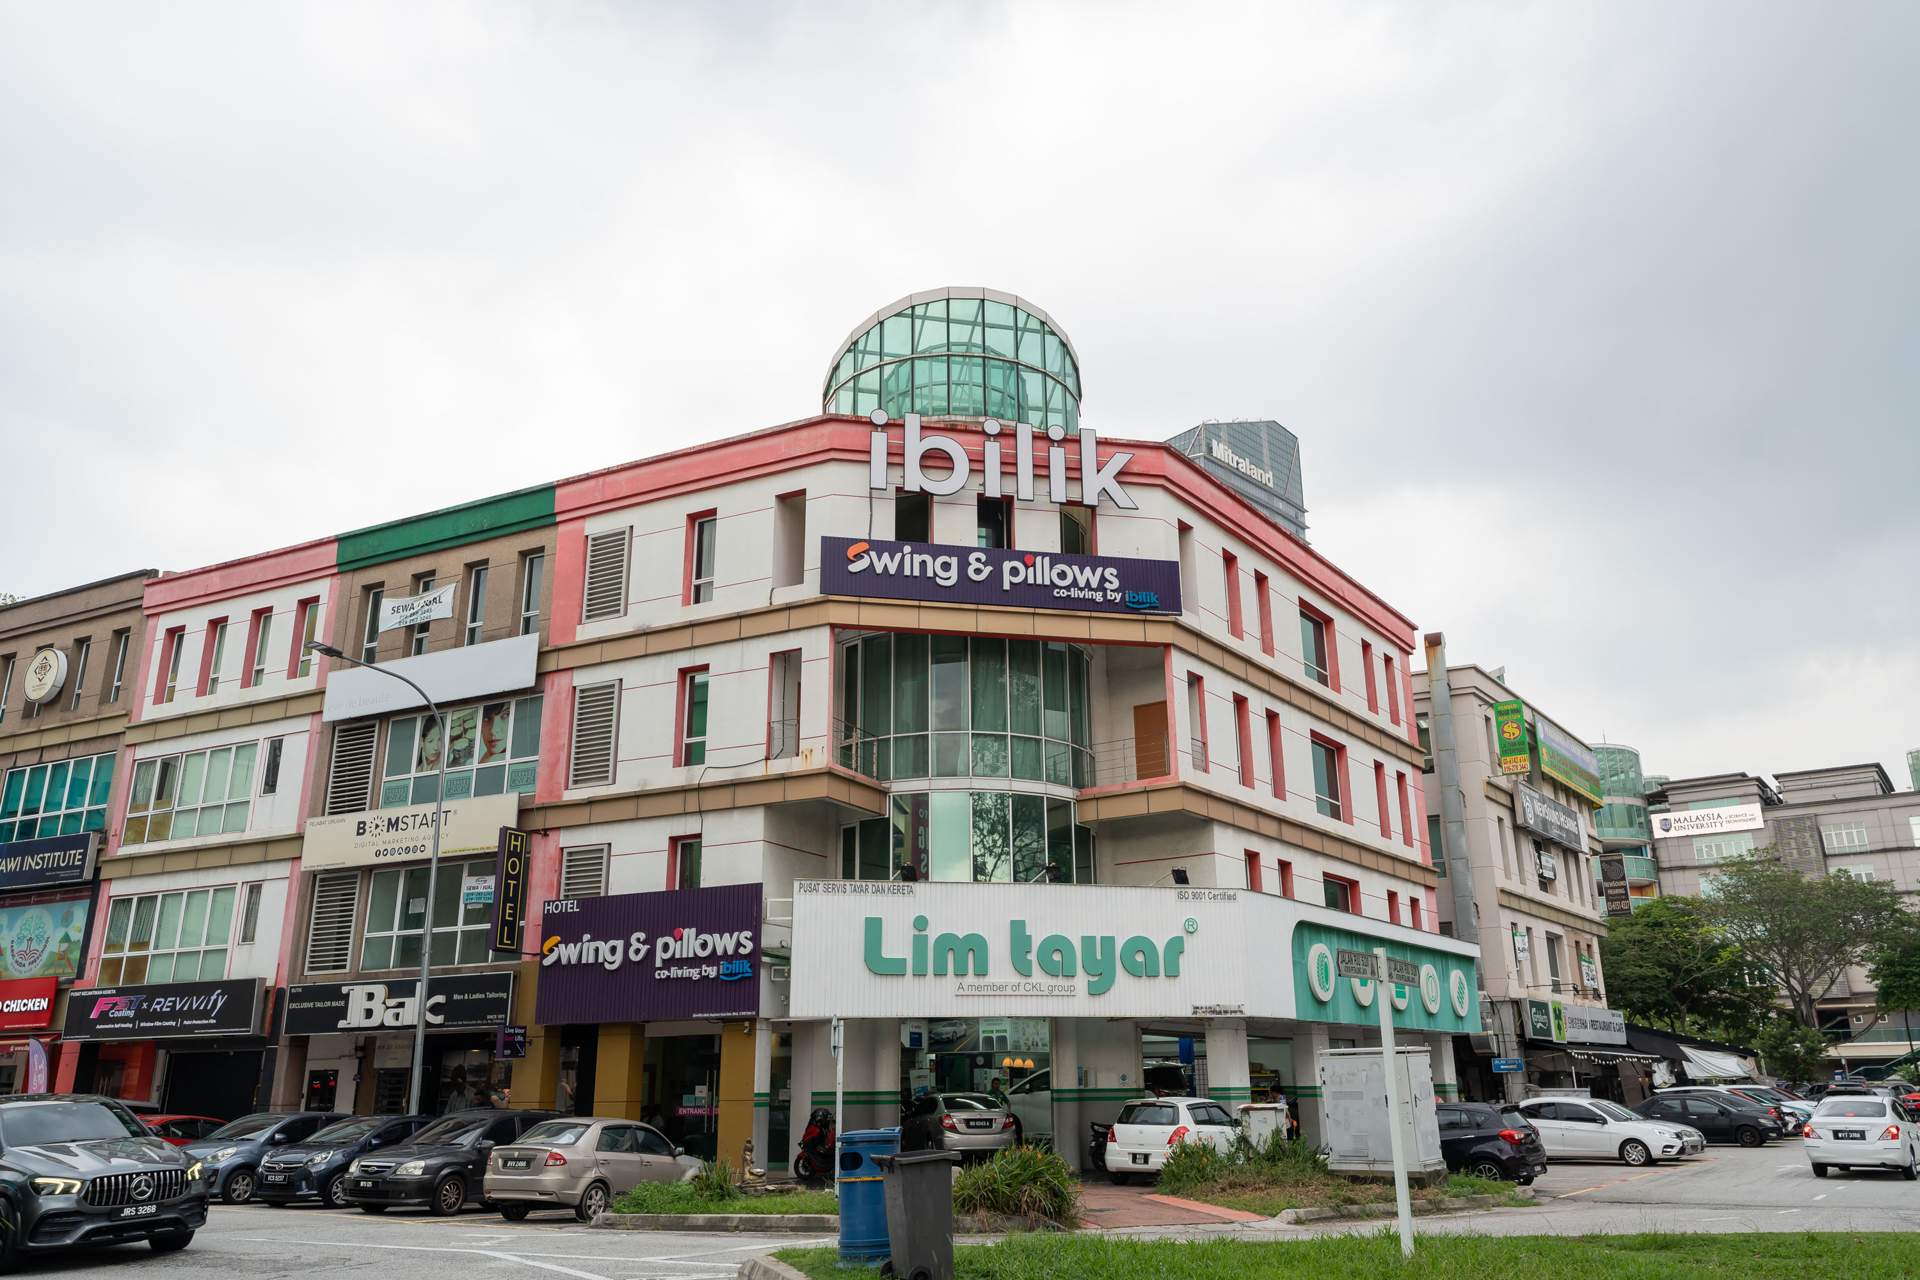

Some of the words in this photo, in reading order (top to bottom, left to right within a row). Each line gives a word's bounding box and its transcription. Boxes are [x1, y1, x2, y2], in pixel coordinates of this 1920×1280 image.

[869, 408, 1139, 510] ibilik
[1212, 439, 1274, 488] Mitraland
[847, 541, 958, 587] Swing
[967, 551, 993, 582] &
[1002, 553, 1120, 591] pillows
[1053, 587, 1104, 603] co-living
[1106, 589, 1122, 603] by
[1125, 590, 1160, 606] ibilik
[391, 602, 415, 615] SEWA
[1673, 812, 1723, 825] MALAYSIA
[1674, 820, 1724, 832] UNIVERSITY
[0, 856, 22, 873] AWI
[22, 849, 84, 871] INSTITUTE
[503, 834, 522, 944] HOTEL
[799, 882, 820, 893] PUSAT
[823, 883, 847, 894] SERVIS
[849, 883, 870, 894] TAYAR
[871, 884, 886, 895] DAN
[887, 884, 914, 895] KERETA
[1177, 890, 1190, 900] ISO
[1191, 891, 1206, 900] 9001
[1207, 891, 1237, 901] Certified
[544, 900, 580, 915] HOTEL
[542, 933, 625, 971] Swing
[628, 931, 651, 962] &
[655, 927, 754, 967] pillows
[864, 914, 989, 976] Lim
[1009, 919, 1185, 996] tayar
[655, 966, 701, 980] co-living
[701, 964, 718, 978] by
[719, 959, 753, 977] ibilik
[469, 992, 485, 1000] Ladies
[486, 991, 508, 999] Tailoring
[957, 982, 965, 992] A
[967, 982, 1009, 992] member
[1010, 982, 1021, 992] of
[1047, 983, 1076, 995] group
[3, 997, 49, 1013] CHICKEN
[289, 1001, 315, 1009] EXCLUSIVE
[315, 1000, 331, 1008] TAILOR
[108, 1008, 135, 1018] Coating
[120, 1207, 136, 1217] JRS
